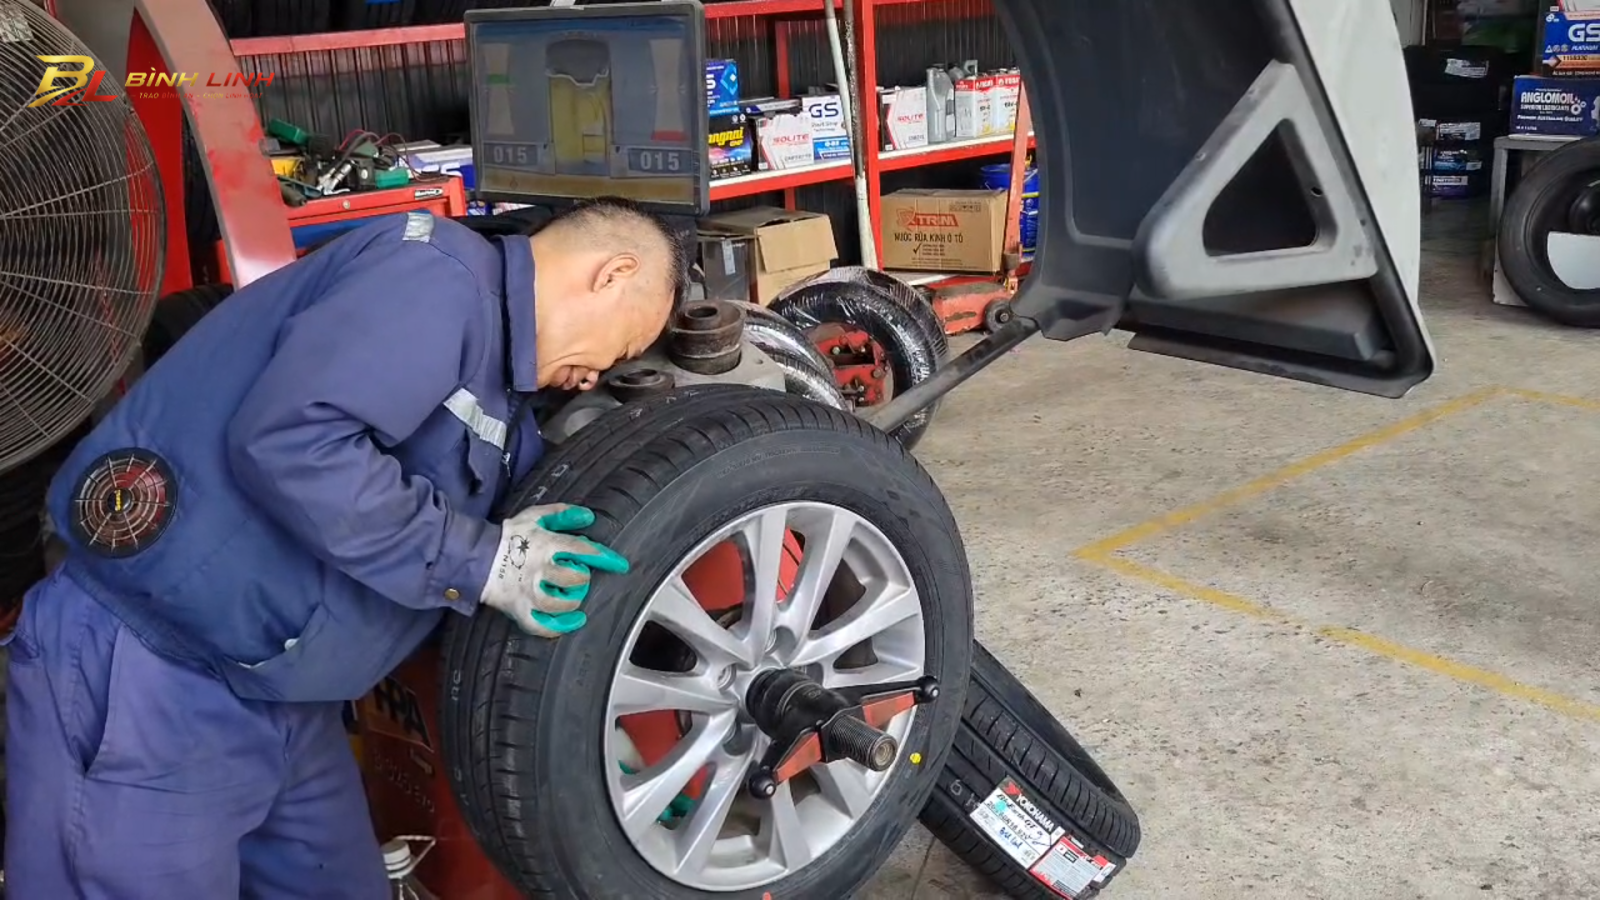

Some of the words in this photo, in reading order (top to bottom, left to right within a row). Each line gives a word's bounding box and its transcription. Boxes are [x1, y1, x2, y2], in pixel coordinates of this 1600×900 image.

[1521, 92, 1575, 104] ANGLOMOIL
[808, 102, 839, 118] GS
[493, 146, 527, 164] 015
[640, 153, 680, 171] 015
[1016, 793, 1055, 832] YOKOHAMA
